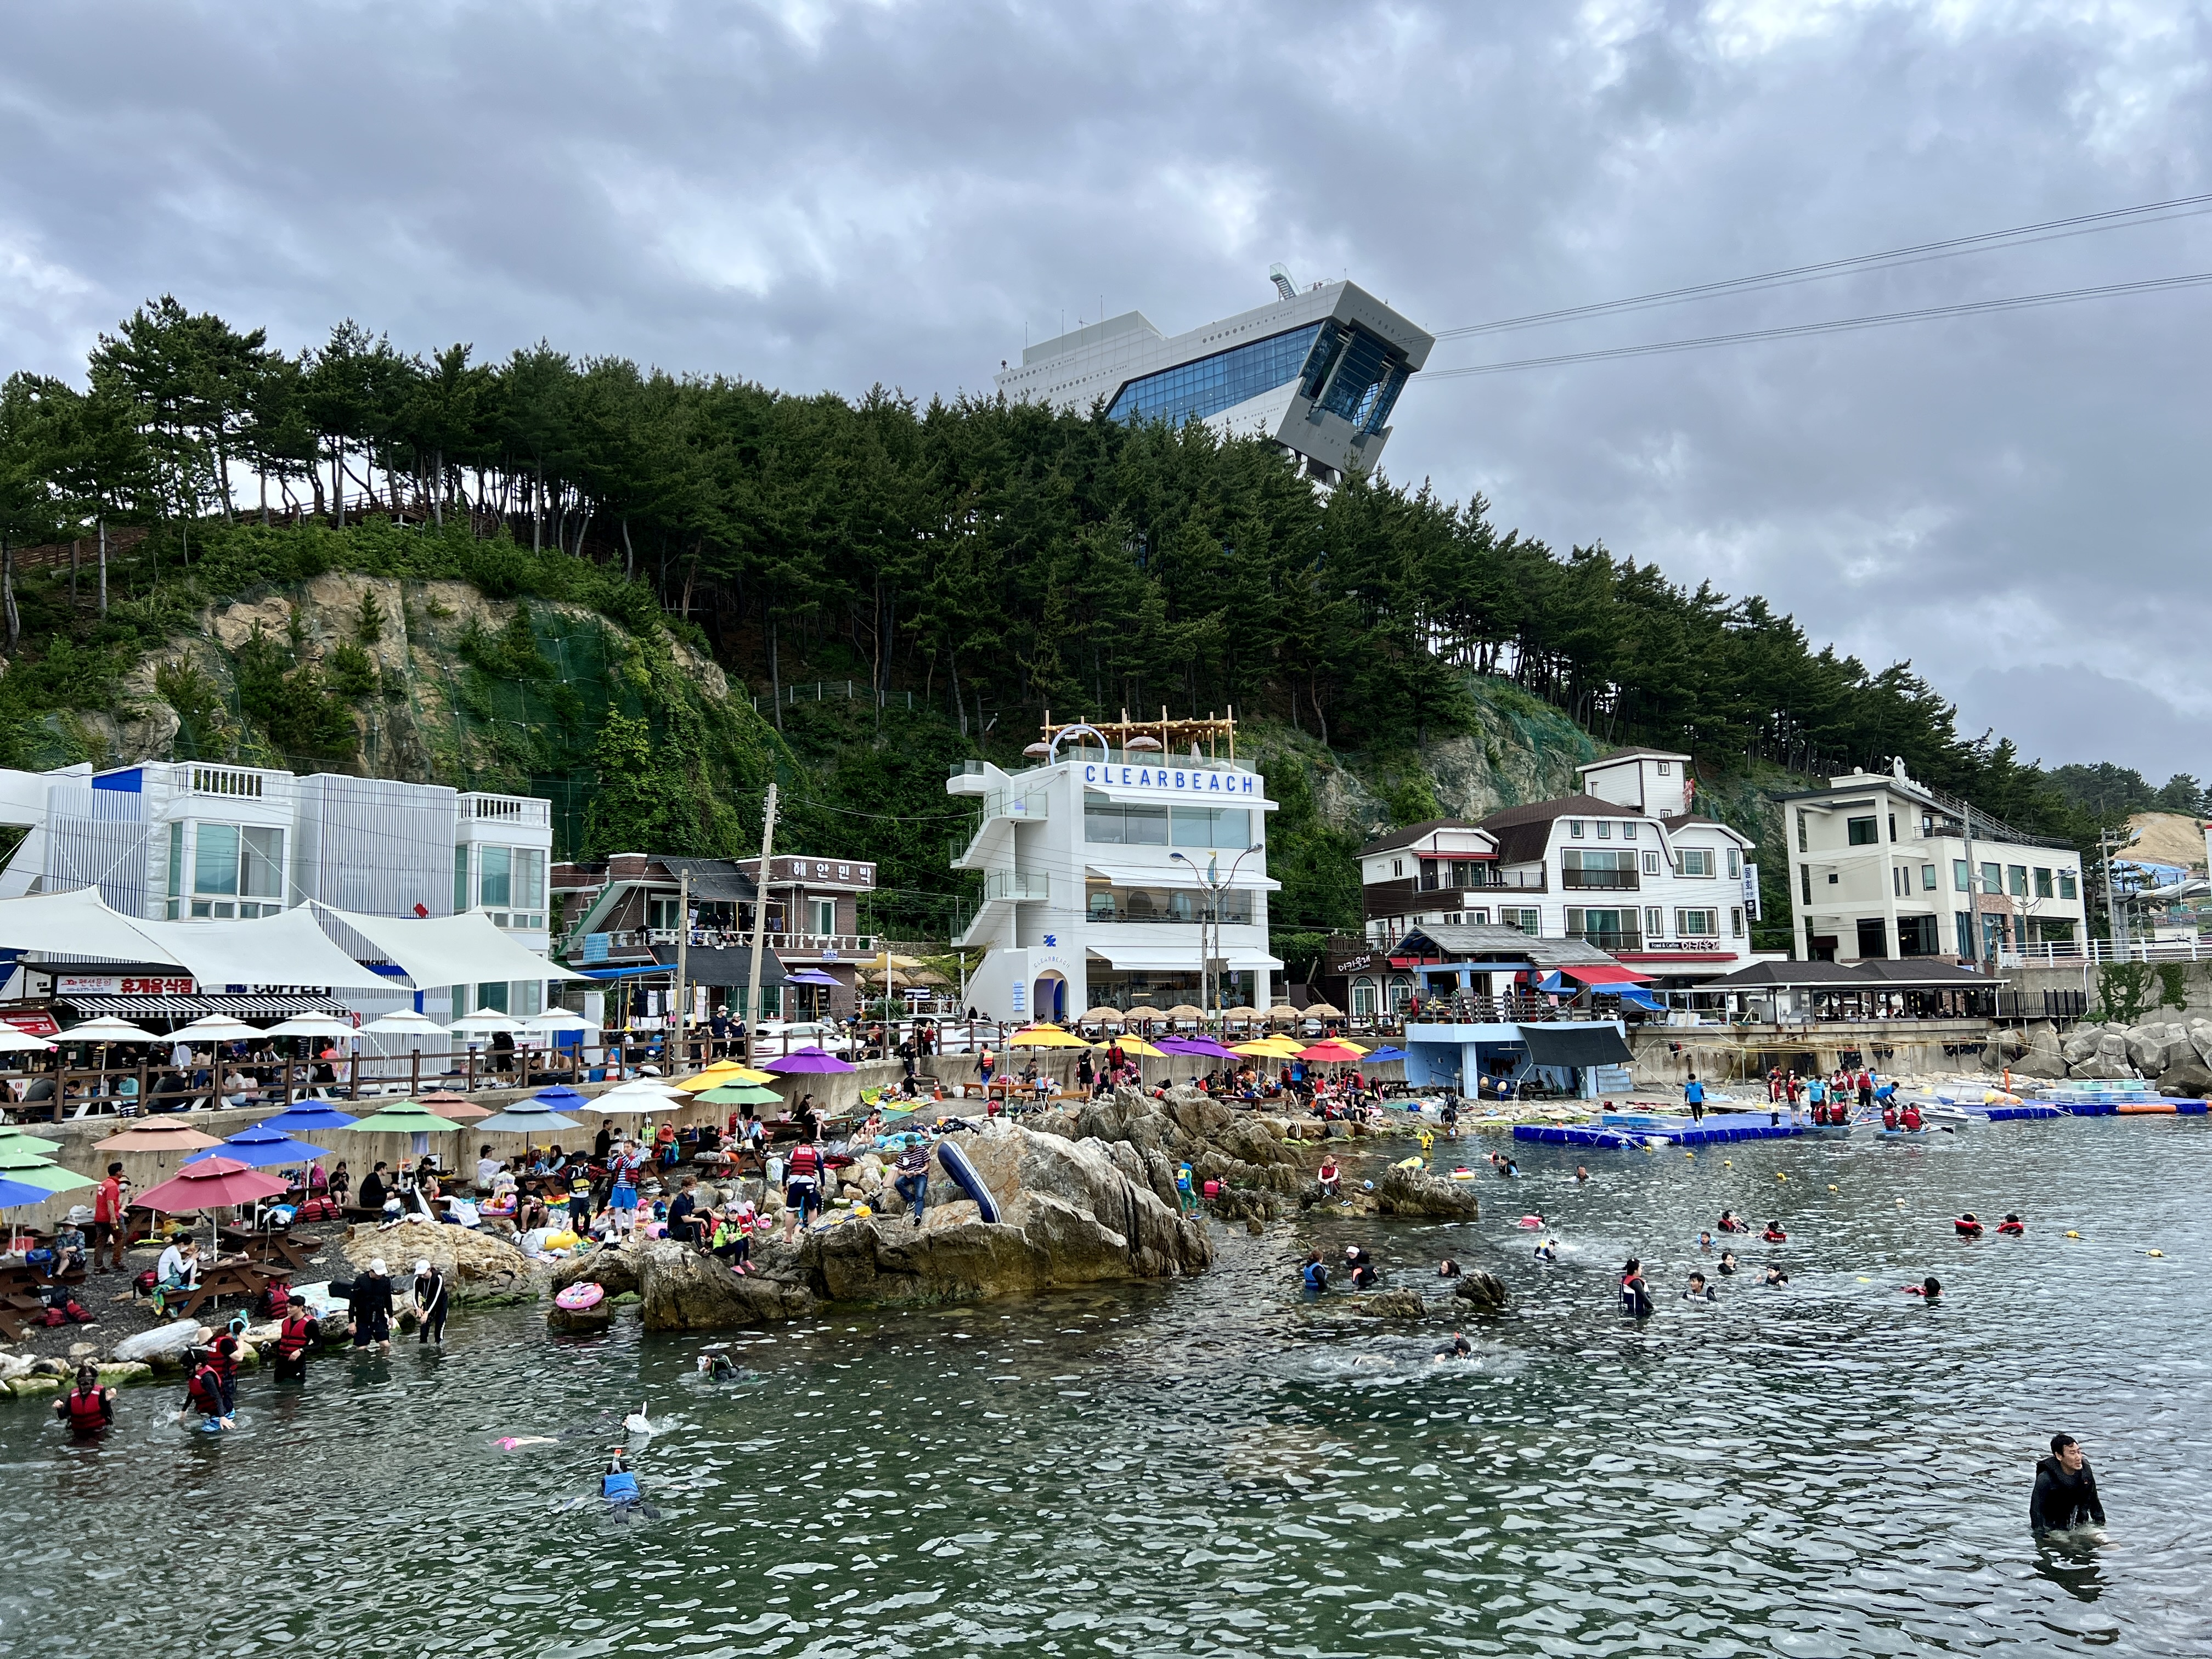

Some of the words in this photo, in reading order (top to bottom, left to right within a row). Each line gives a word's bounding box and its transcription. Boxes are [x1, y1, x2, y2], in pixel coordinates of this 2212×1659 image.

[1085, 765, 1252, 793] CLEARBEACH
[793, 861, 872, 884] 해안민박
[1034, 956, 1070, 968] CLEARBEACH
[78, 978, 111, 987] 펜션문의
[121, 978, 192, 994] 휴게음식점
